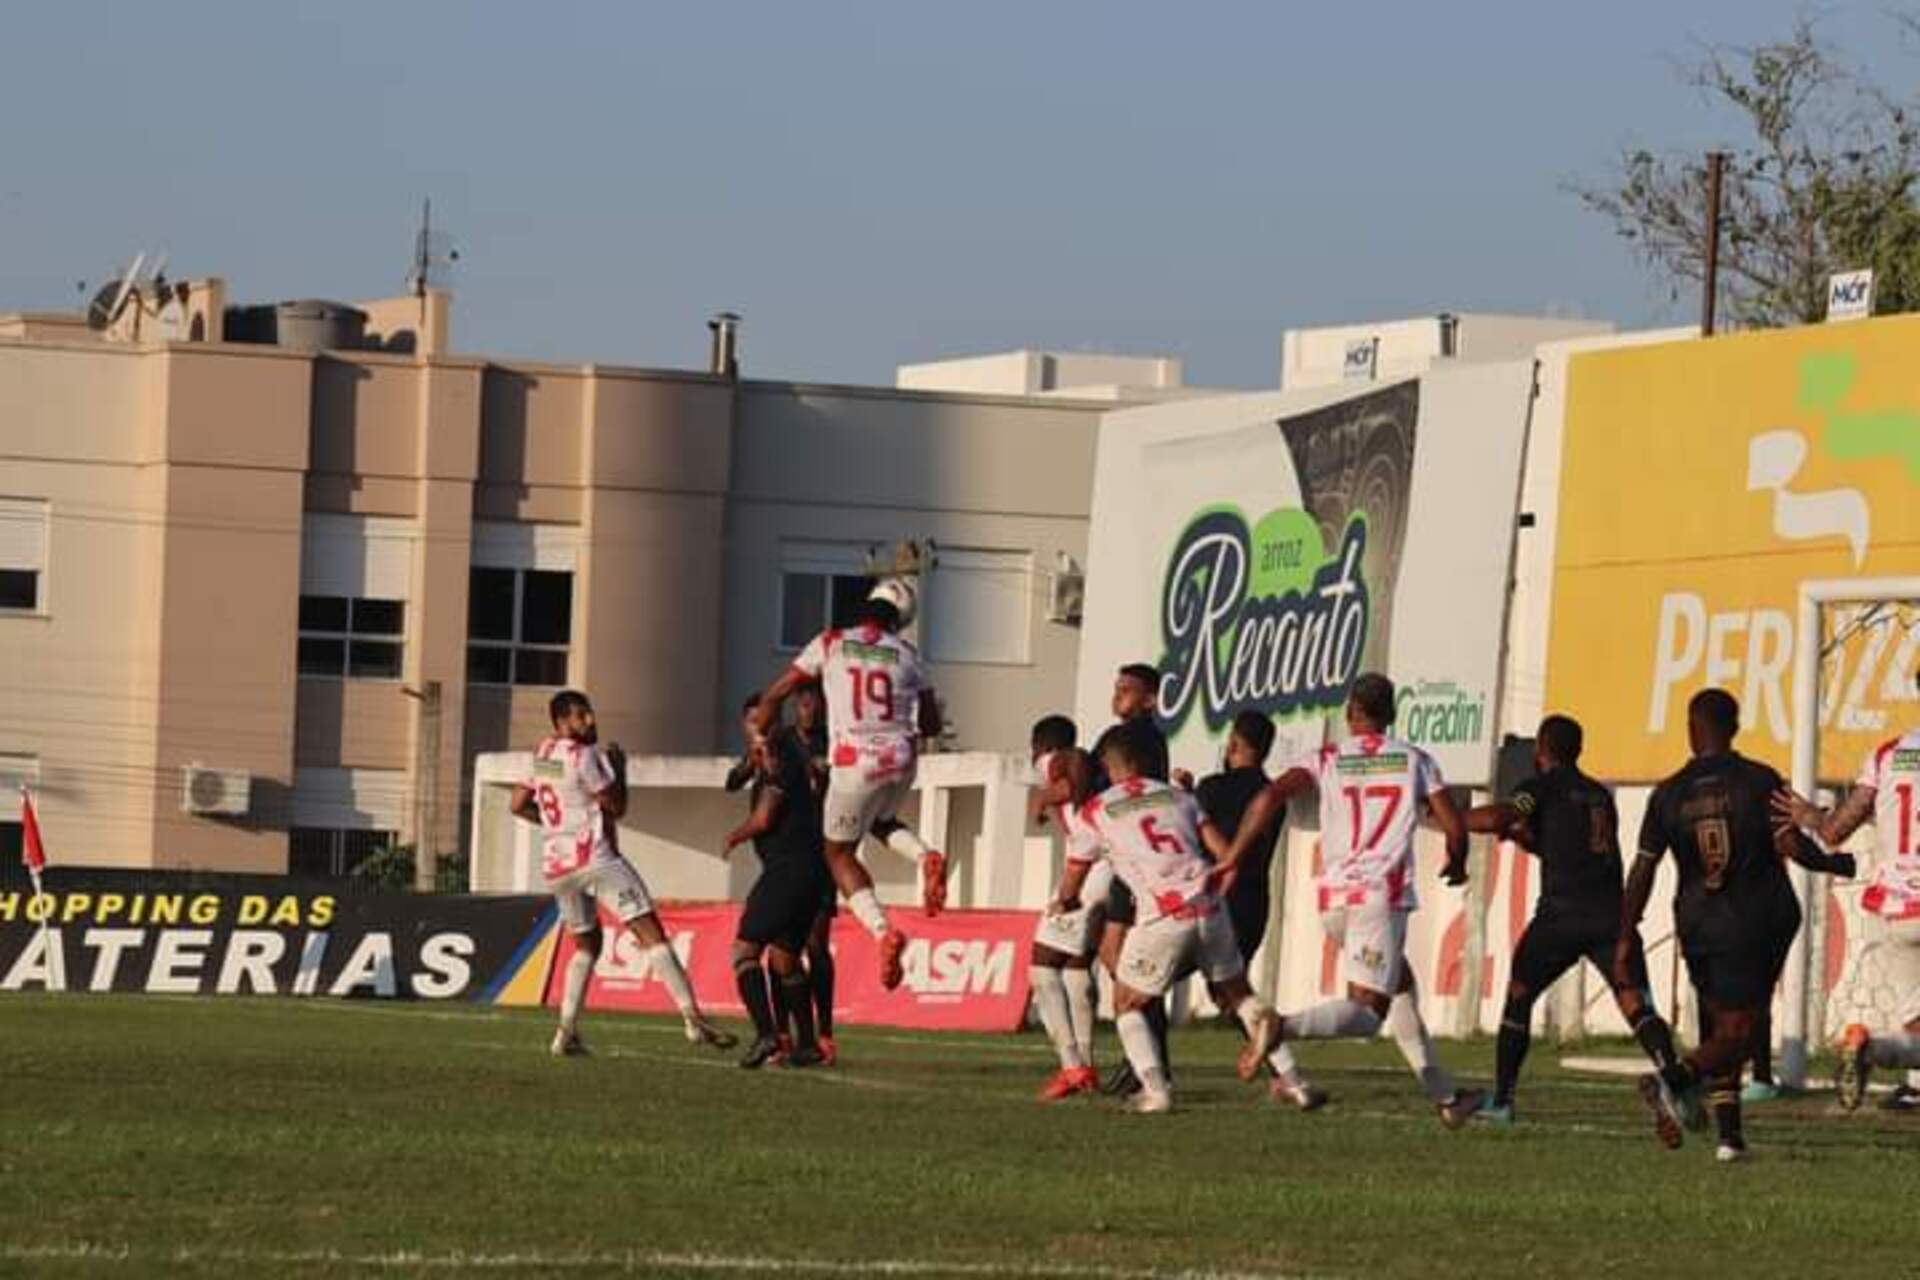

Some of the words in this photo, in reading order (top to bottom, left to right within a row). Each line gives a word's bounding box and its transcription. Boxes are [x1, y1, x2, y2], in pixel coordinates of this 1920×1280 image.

[1261, 539, 1303, 572] arroz
[1157, 532, 1363, 720] Recanto
[846, 666, 894, 722] 19
[1342, 785, 1403, 851] 17
[1896, 783, 1920, 854] 1
[237, 895, 337, 926] DAS
[901, 939, 1014, 993] ASM
